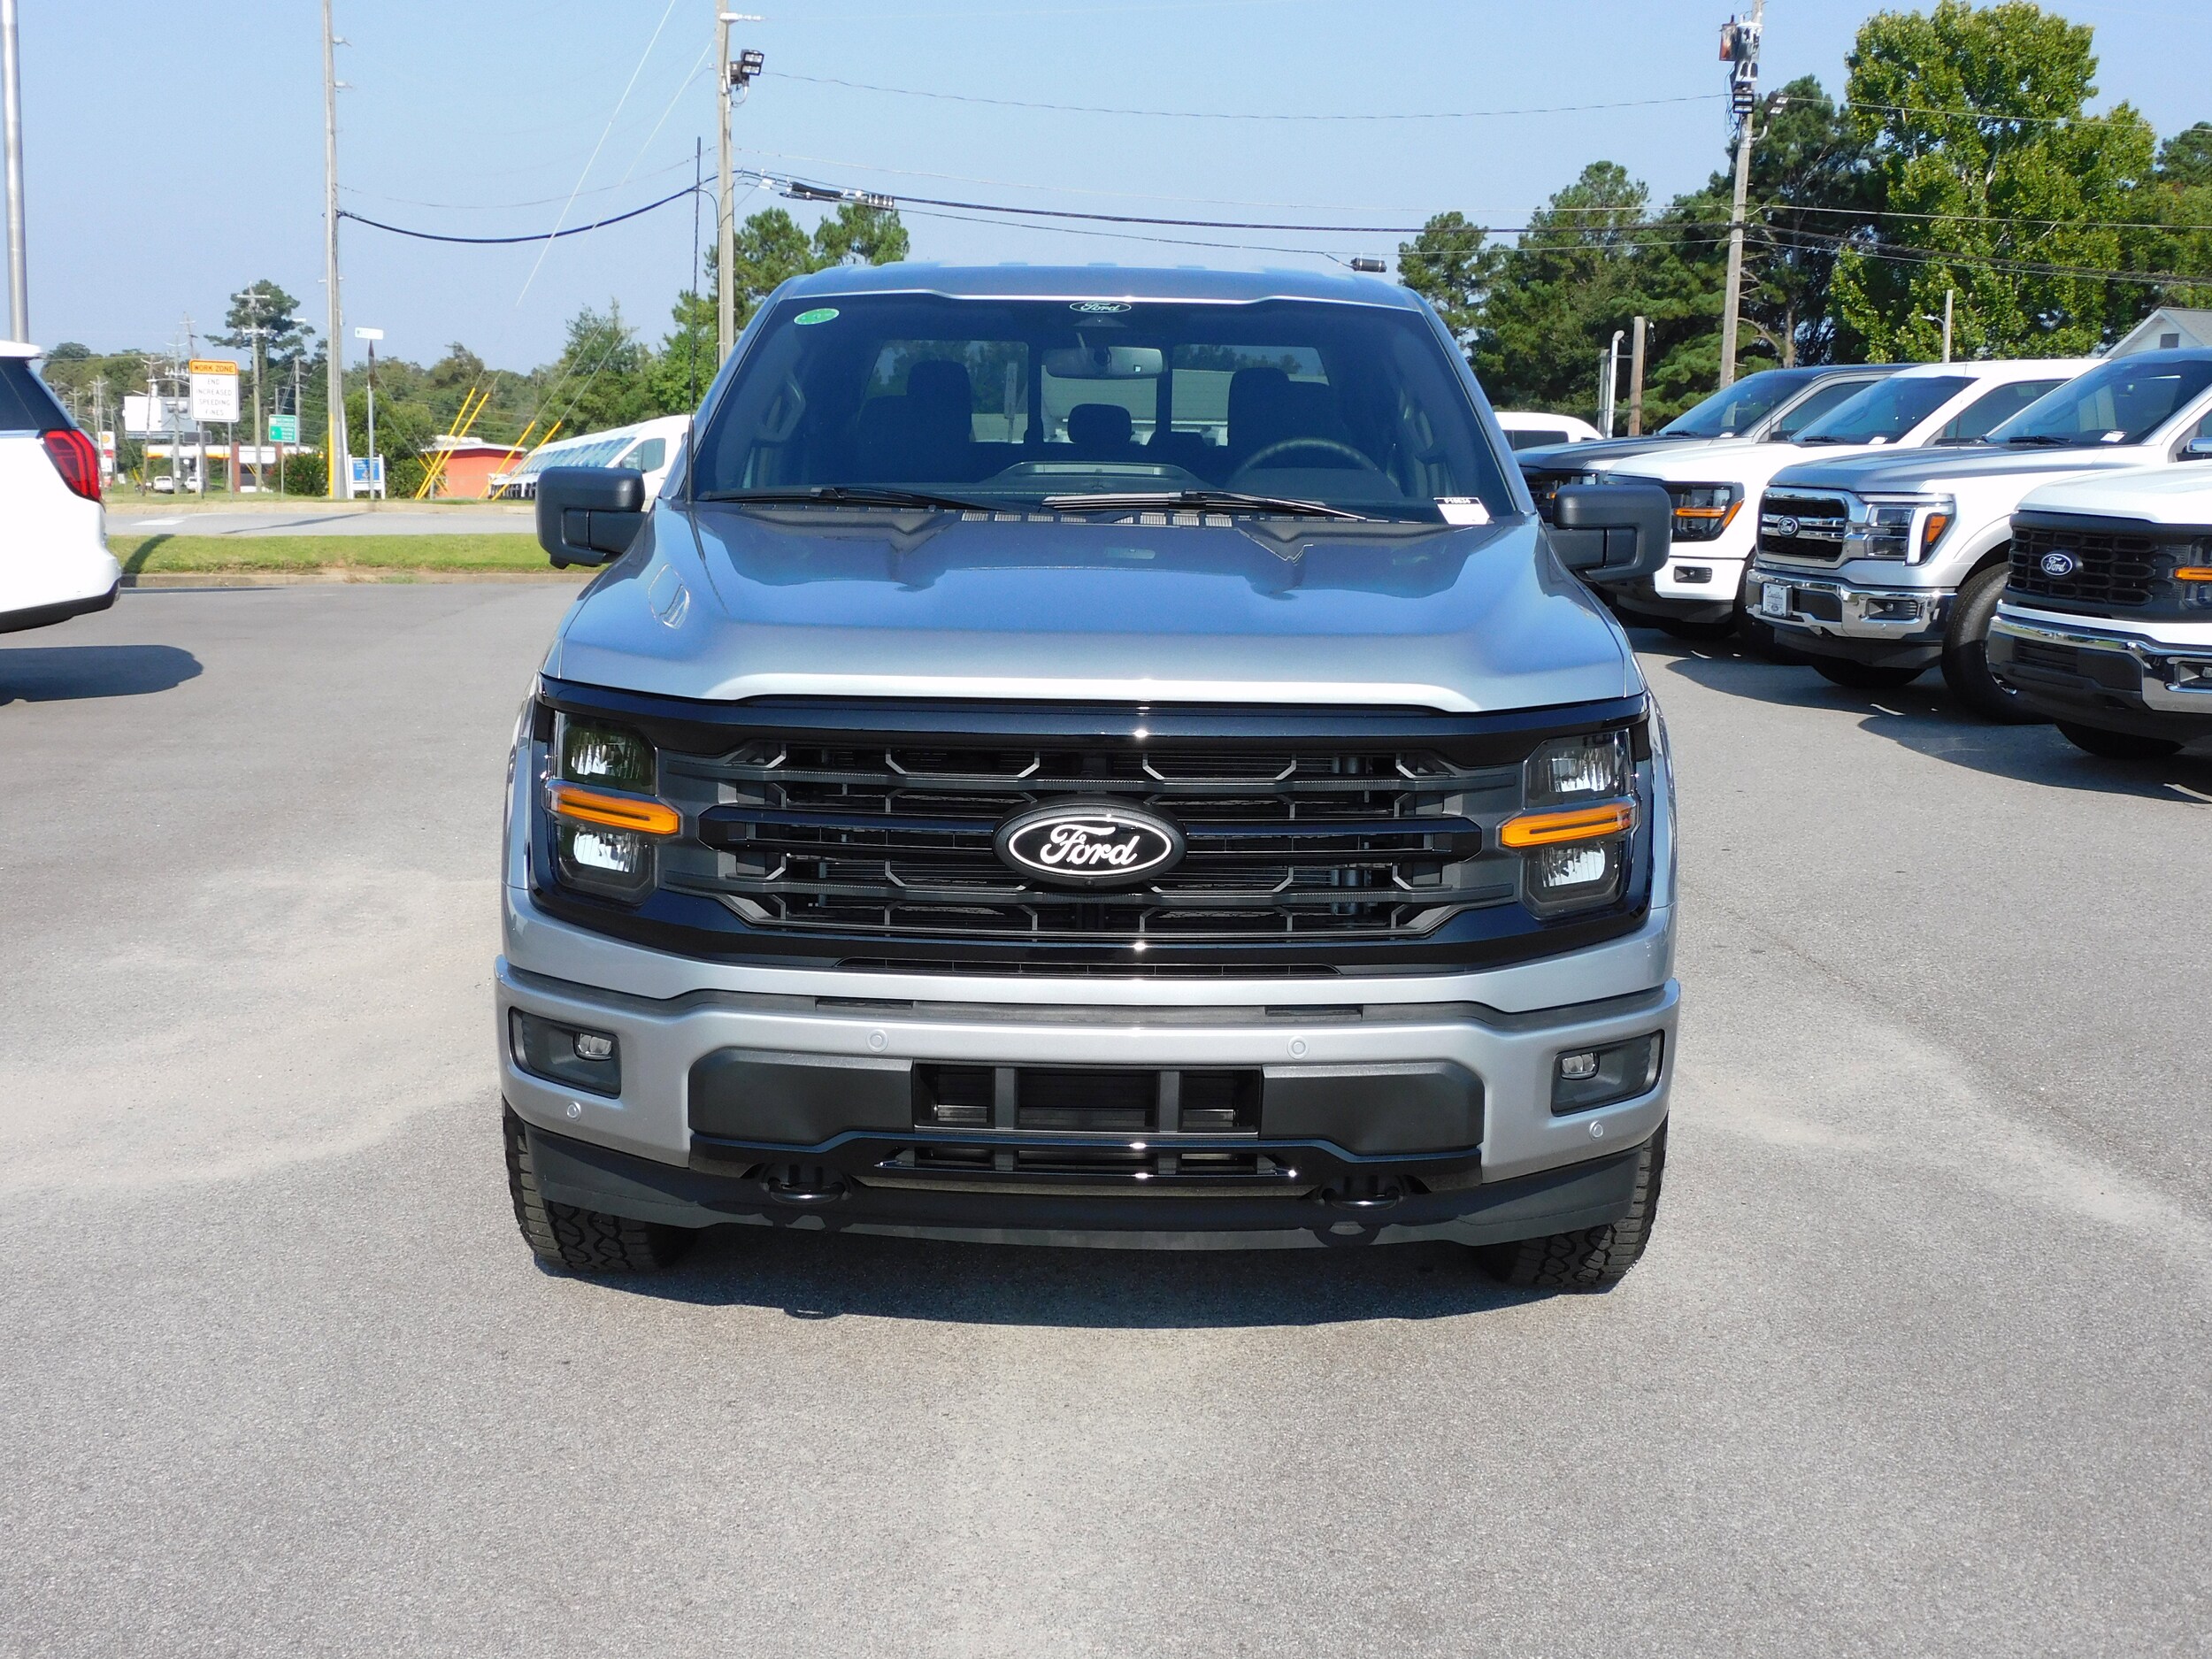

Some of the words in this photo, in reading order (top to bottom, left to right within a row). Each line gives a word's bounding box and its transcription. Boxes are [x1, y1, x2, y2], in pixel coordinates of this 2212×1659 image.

[1080, 302, 1120, 311] Ford
[2046, 556, 2067, 572] Ford
[1040, 824, 1141, 865] Ford
